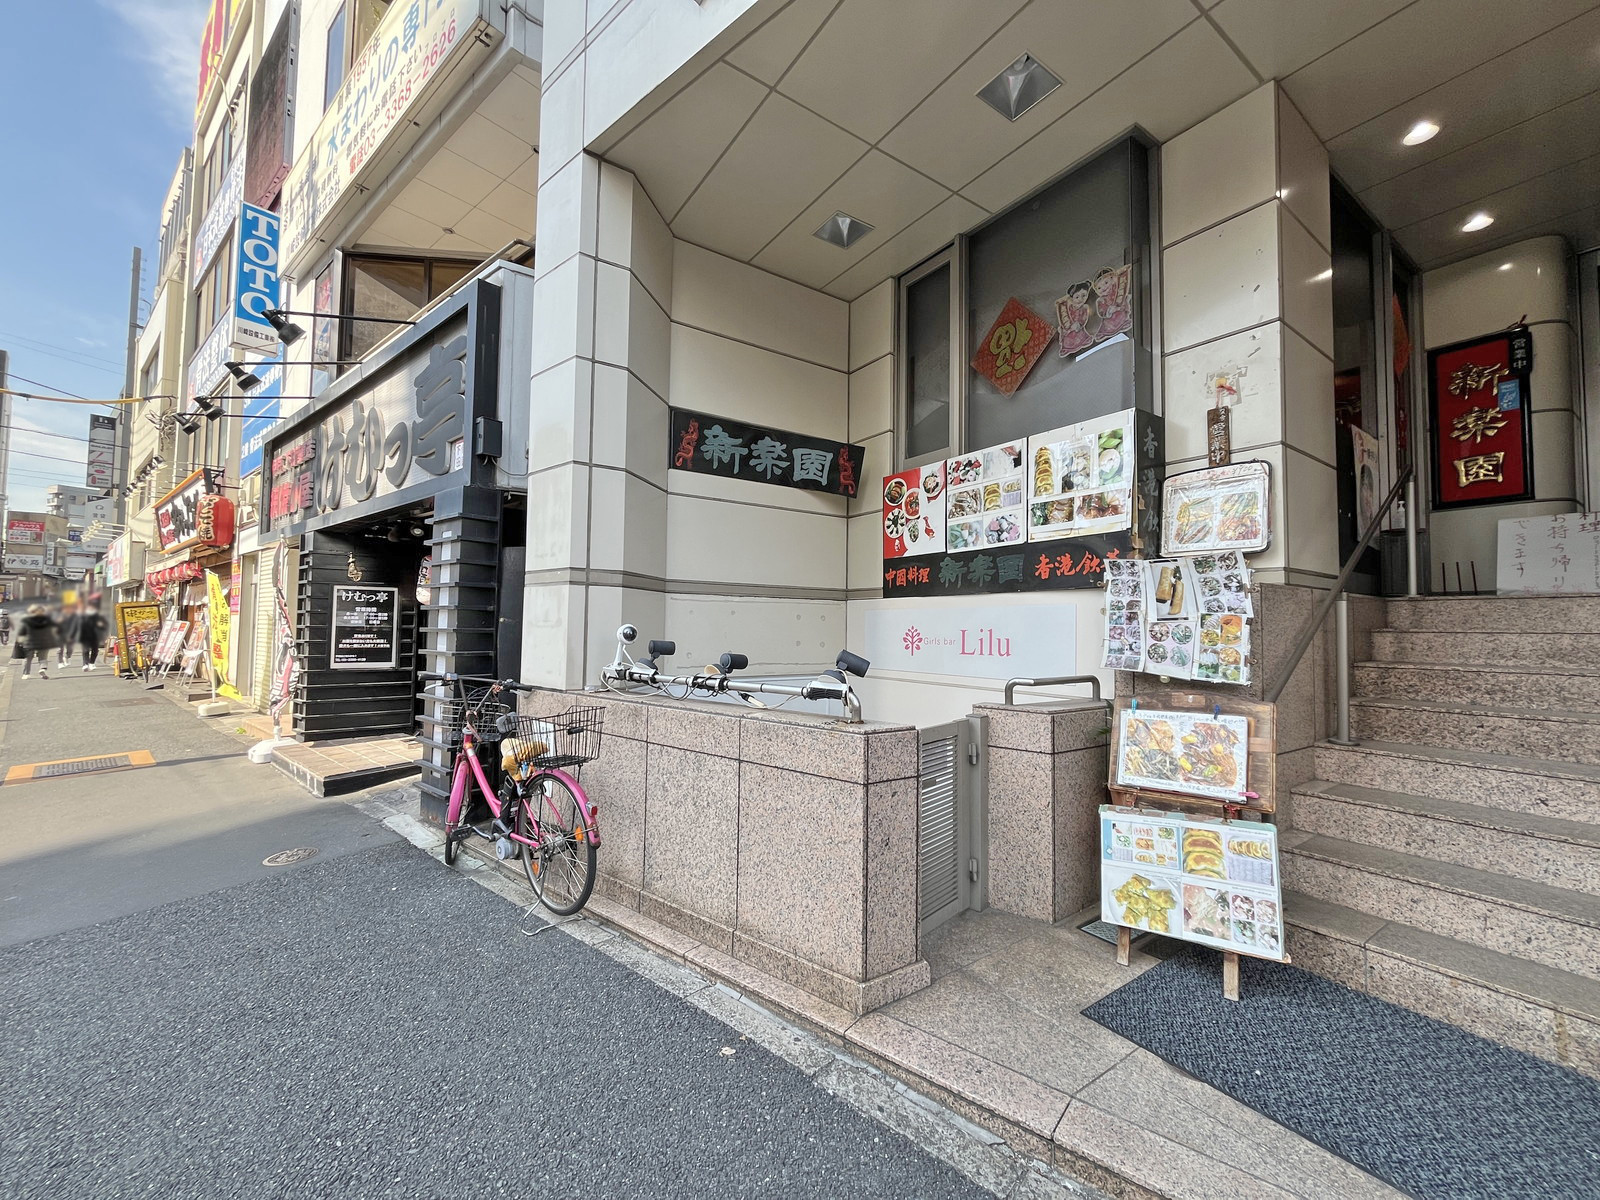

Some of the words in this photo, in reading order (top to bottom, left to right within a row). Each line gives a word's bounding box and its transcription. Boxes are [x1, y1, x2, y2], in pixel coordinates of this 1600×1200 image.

[326, 0, 444, 167] 水まわりの専
[241, 209, 279, 318] TOTO
[700, 424, 834, 486] 新楽園
[342, 591, 389, 603] けむっ亭
[885, 565, 930, 588] 中国料理
[923, 637, 941, 646] Girls
[944, 638, 956, 646] bar
[959, 628, 1012, 657] Lilu
